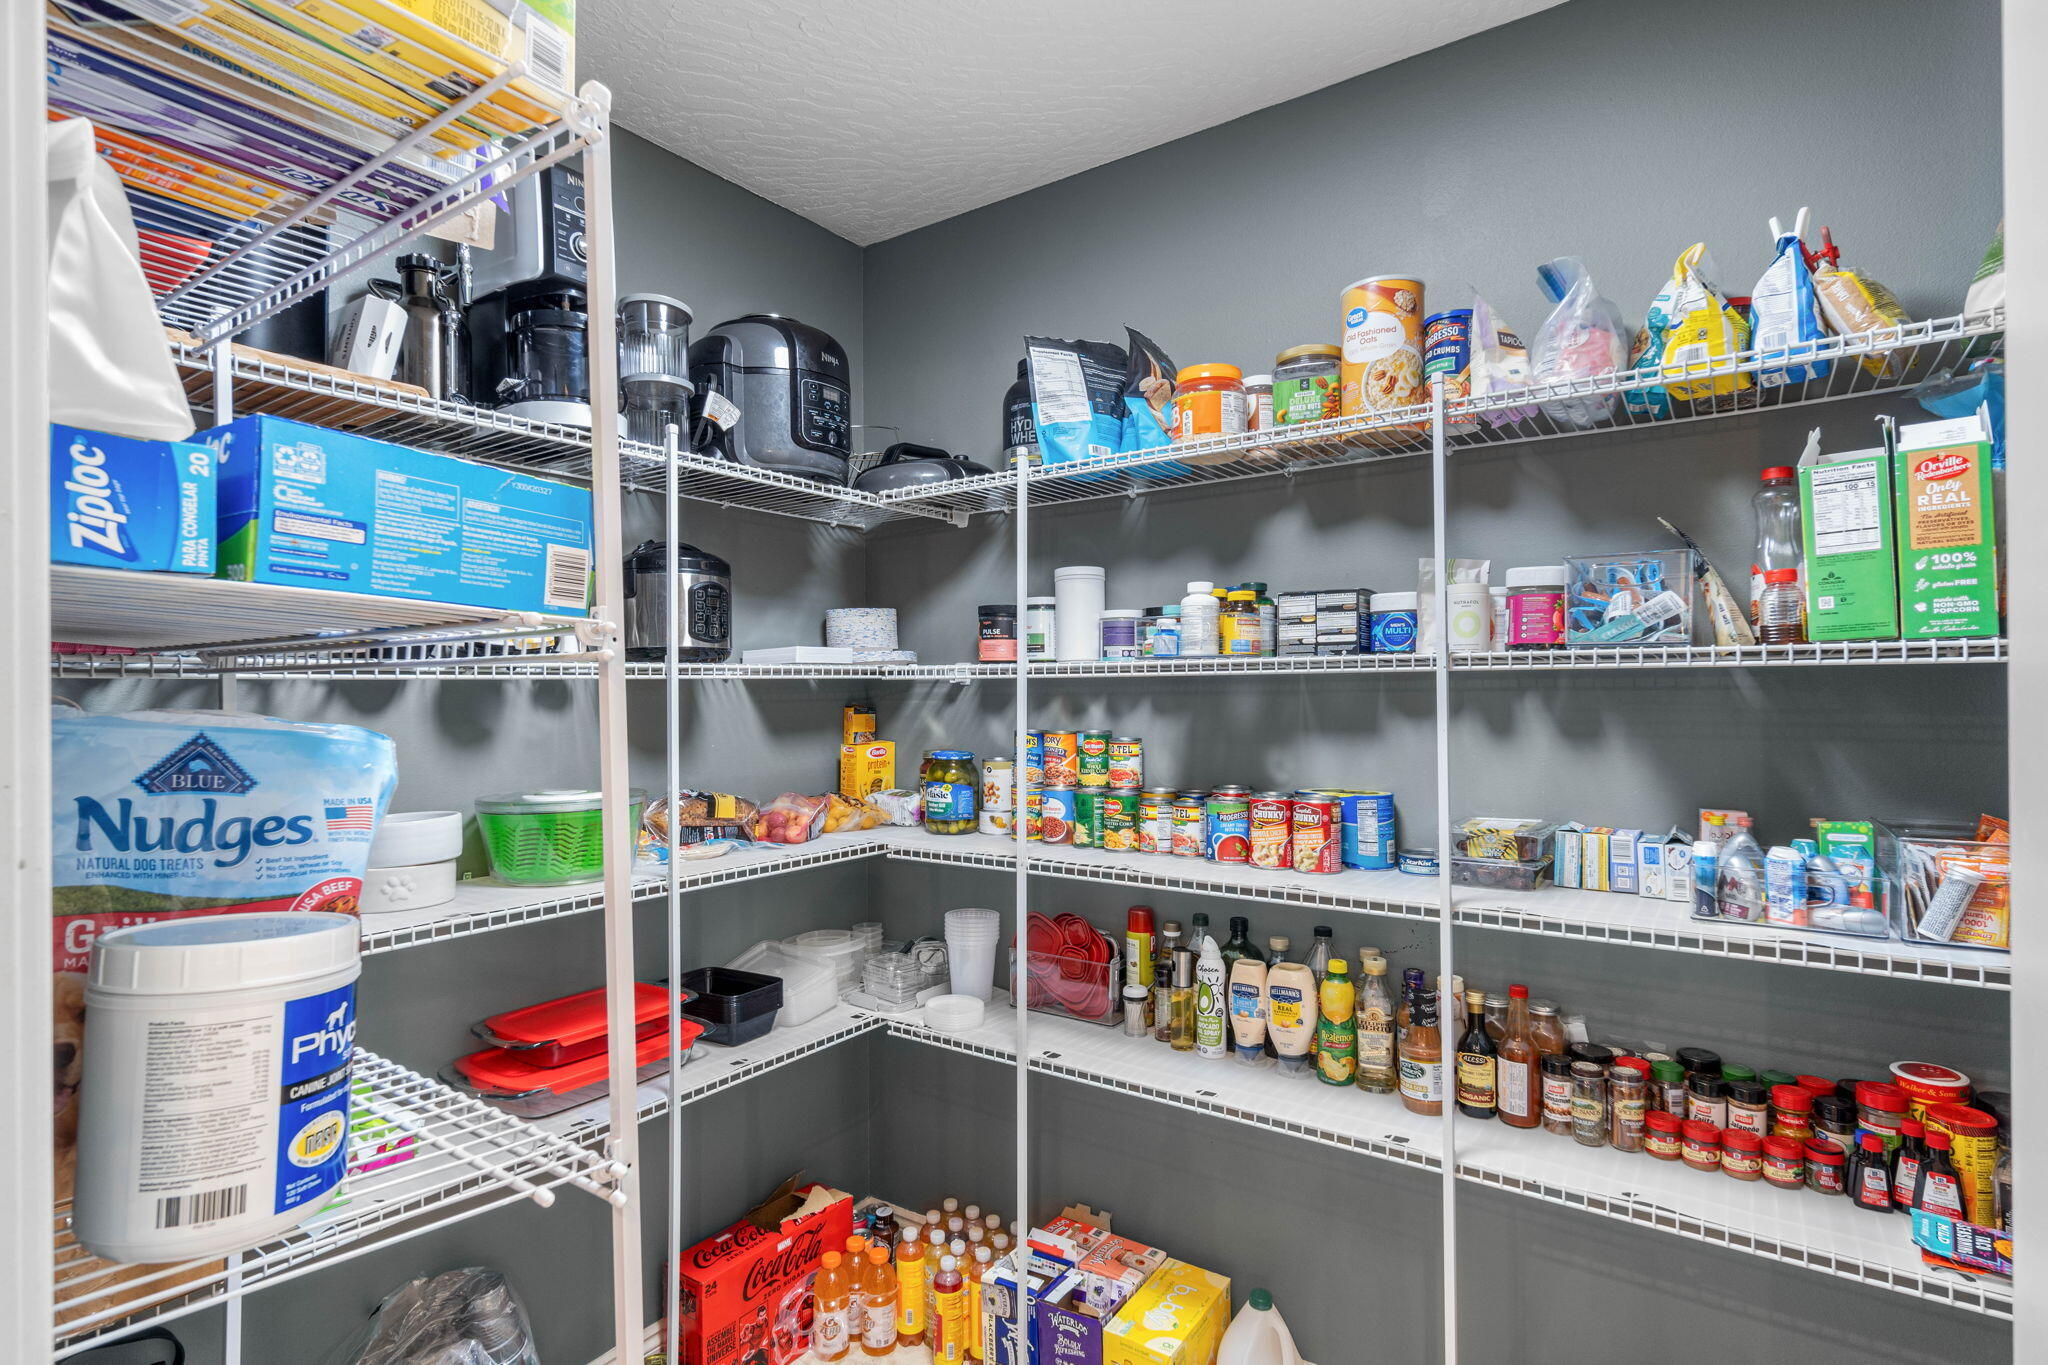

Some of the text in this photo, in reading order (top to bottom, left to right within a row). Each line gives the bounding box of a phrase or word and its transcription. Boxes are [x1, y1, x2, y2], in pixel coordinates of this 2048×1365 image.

[567, 171, 585, 188] NIN
[1346, 325, 1397, 343] Old Fashioned
[1360, 336, 1377, 345] Oats
[1425, 326, 1459, 348] OGRESSO
[1433, 345, 1460, 356] CRUMBS
[821, 351, 840, 367] NINJA
[1010, 419, 1035, 433] HYD
[1010, 430, 1036, 445] WHE
[189, 452, 210, 477] 20
[1813, 462, 1875, 475] Nutrition Facts
[1920, 456, 1964, 473] Orville
[1925, 480, 1962, 495] Only
[64, 443, 128, 555] Ziploc
[1917, 490, 1971, 506] REAL
[1917, 502, 1971, 512] INGREDIENTS
[182, 482, 198, 567] PARA CONGELAR
[197, 538, 209, 568] PINTA
[1931, 552, 1977, 564] 100%
[1933, 600, 1979, 608] NON-GMO
[1933, 606, 1980, 614] POPCORN
[1385, 627, 1411, 635] MULTI
[171, 774, 226, 789] BLUE
[323, 798, 345, 806] MADE
[357, 797, 373, 805] USA
[1253, 809, 1284, 820] CHUNKY
[73, 795, 314, 868] Nudges
[76, 857, 205, 871] NATURAL DOG TREATS
[1406, 858, 1432, 867] StarKist
[85, 871, 197, 880] ENHANCED WITH MINERALS
[297, 881, 353, 912] USA BEEF
[1270, 988, 1300, 998] HELLMANN'S
[1463, 1054, 1486, 1063] ALESSI
[290, 1077, 327, 1099] CANINE
[1899, 1080, 1957, 1098] Walker & Sons
[1459, 1092, 1492, 1102] ORGANIC
[1936, 1222, 1951, 1244] MILD
[1956, 1223, 1973, 1255] SEASONING
[1975, 1234, 1993, 1252] TACO
[743, 1220, 826, 1302] Coca-Cola
[705, 1280, 718, 1295] 24
[763, 1270, 805, 1300] ZERO SUGAR
[1048, 1311, 1089, 1336] WATERLOO
[706, 1324, 737, 1347] ASSEMBLE
[1056, 1333, 1082, 1350] BOLDLY
[706, 1335, 737, 1355] THE MARVEL
[706, 1342, 737, 1364] UNIVERSE
[1054, 1343, 1087, 1358] REFRESHING
